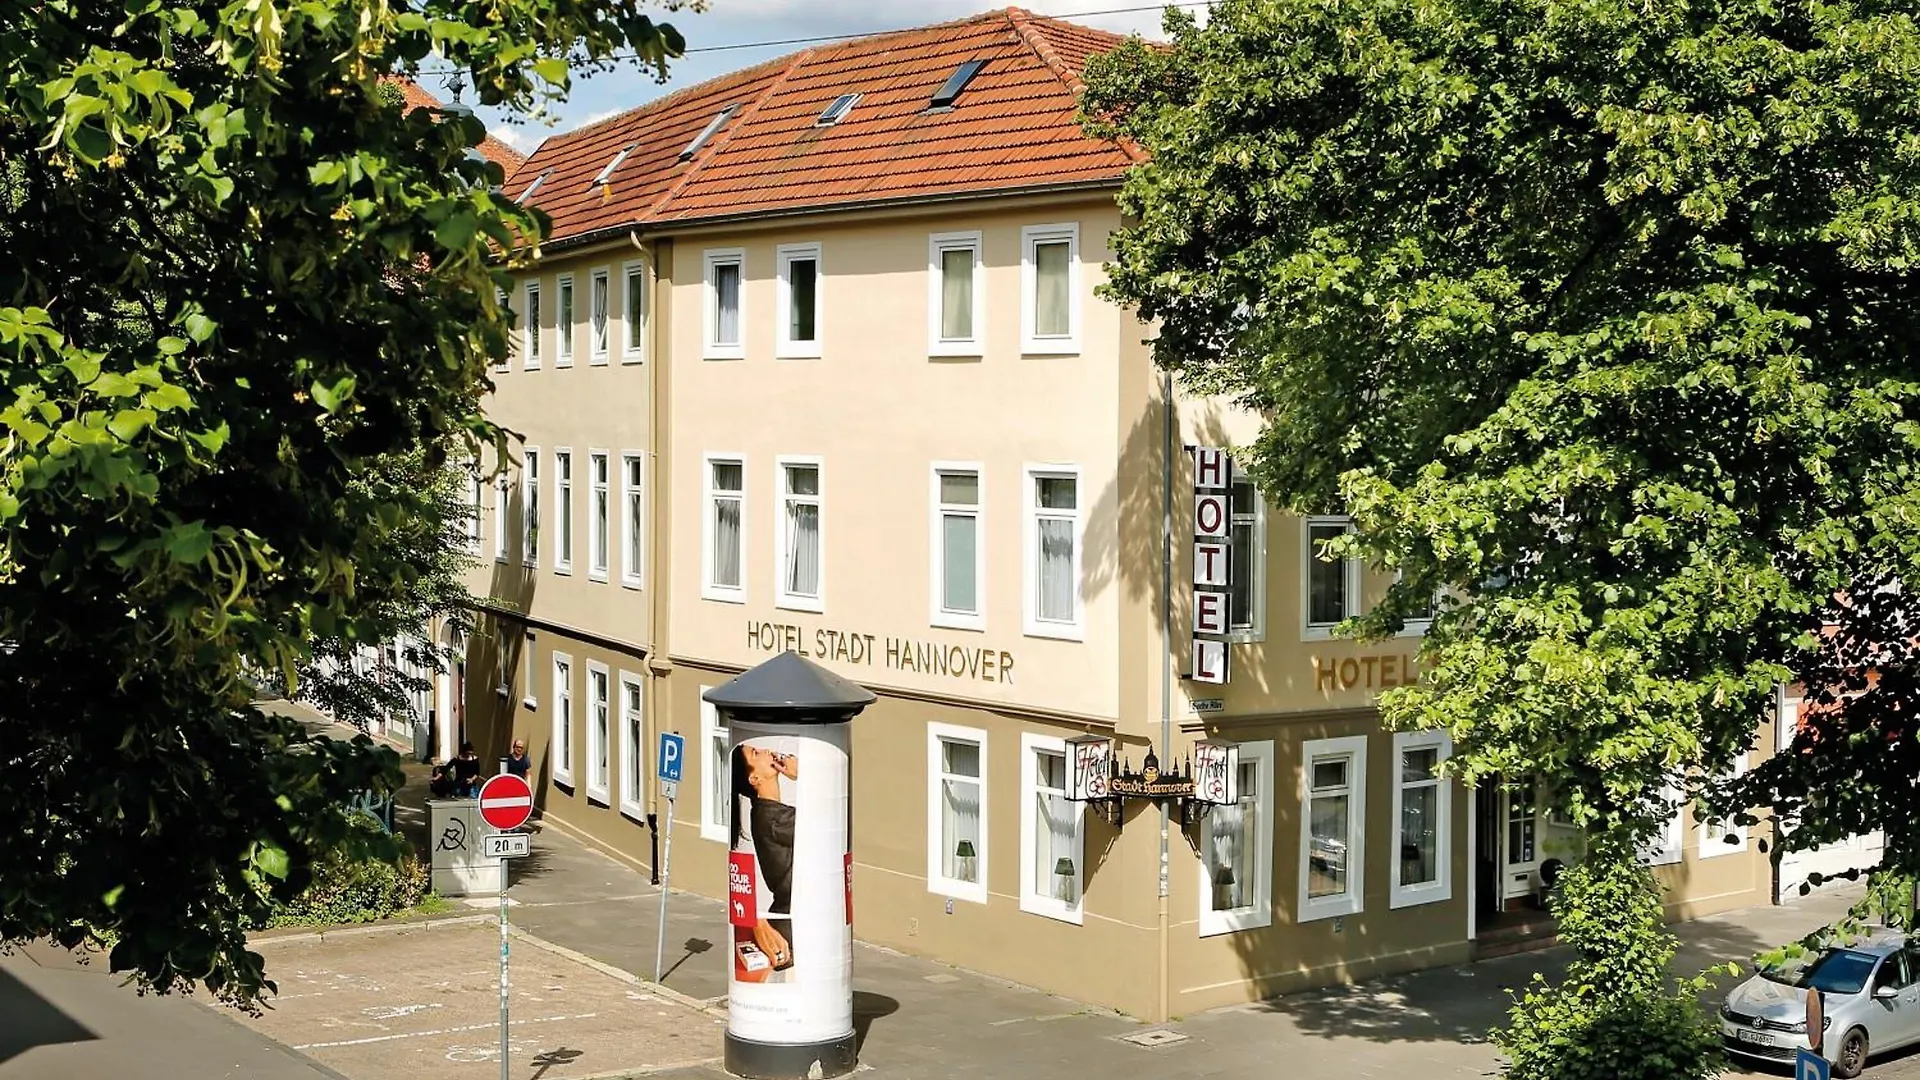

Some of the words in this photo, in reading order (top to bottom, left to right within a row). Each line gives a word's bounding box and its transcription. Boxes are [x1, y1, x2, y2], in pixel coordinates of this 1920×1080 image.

[1198, 449, 1222, 678] HOTEL
[748, 620, 809, 657] HOTEL
[815, 629, 875, 665] STADT
[886, 637, 1014, 685] HANNOVER
[1315, 654, 1417, 691] HOTEL
[664, 740, 678, 773] P
[1112, 778, 1142, 793] Stadt
[1143, 779, 1192, 796] Hannover
[494, 839, 509, 852] 20
